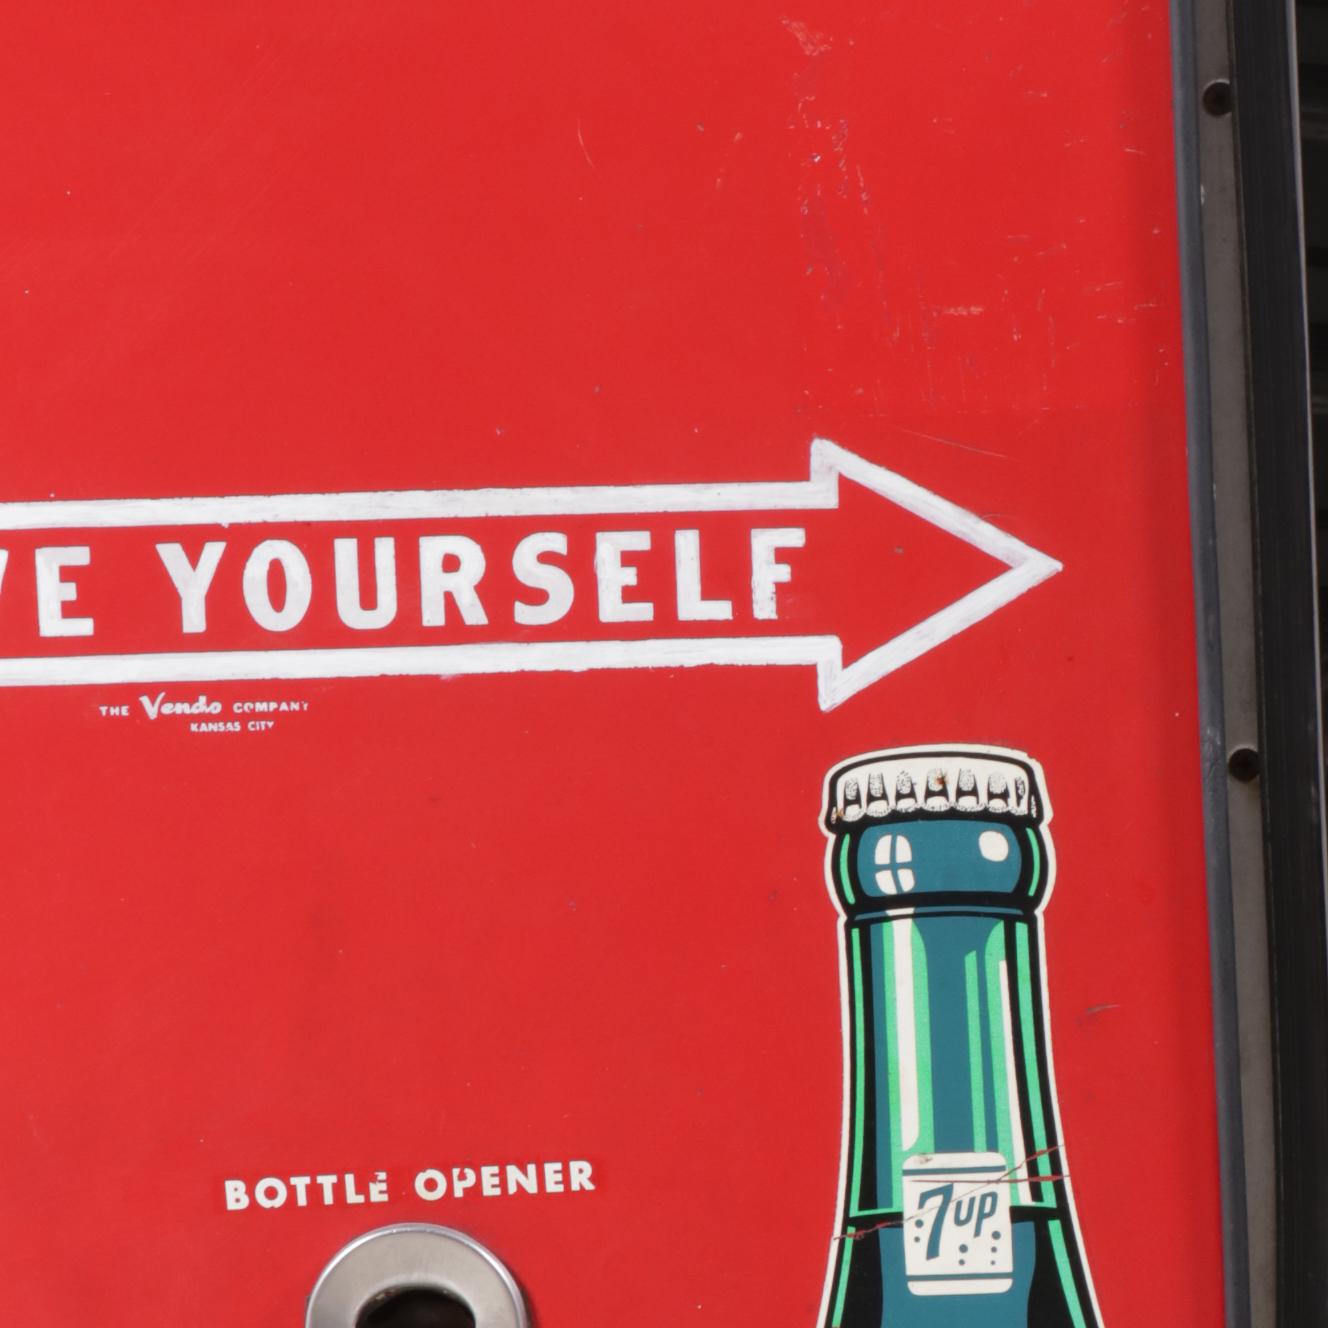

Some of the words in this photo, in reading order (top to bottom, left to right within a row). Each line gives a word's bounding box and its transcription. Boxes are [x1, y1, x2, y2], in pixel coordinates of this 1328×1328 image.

[155, 528, 806, 633] YOURSELF
[99, 705, 129, 717] THE
[138, 691, 223, 720] Vendo
[232, 700, 309, 714] COMPANY
[190, 721, 241, 733] KANSAS
[247, 720, 275, 731] CITY
[224, 1172, 389, 1211] BOTTLE
[414, 1160, 596, 1201] OPENER
